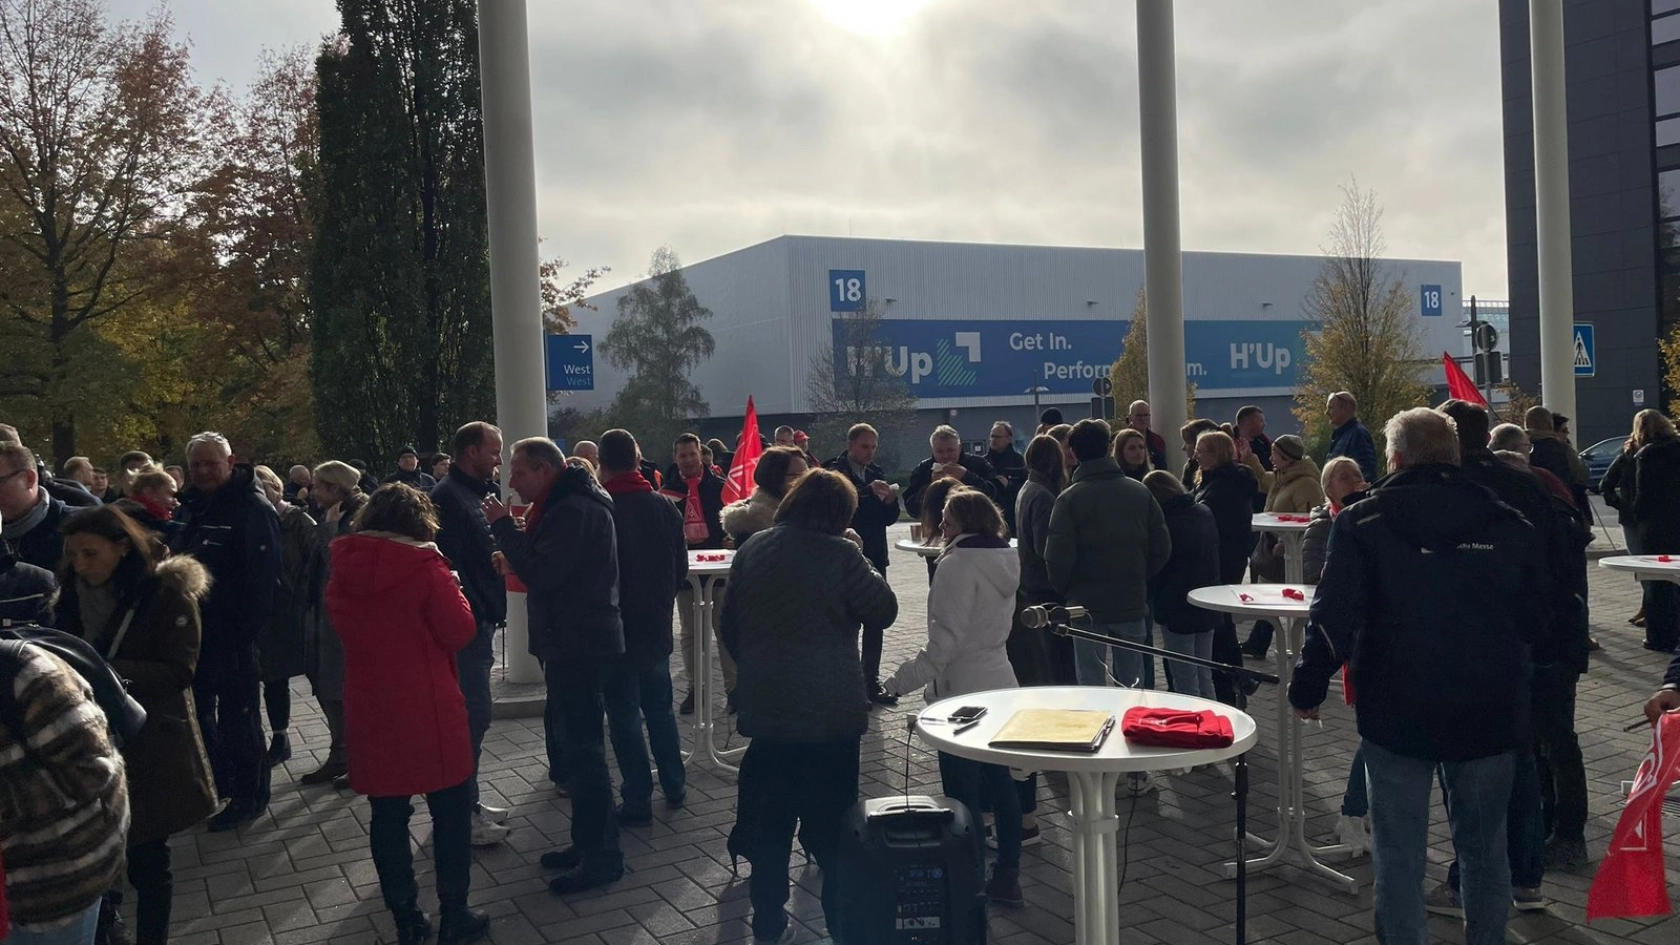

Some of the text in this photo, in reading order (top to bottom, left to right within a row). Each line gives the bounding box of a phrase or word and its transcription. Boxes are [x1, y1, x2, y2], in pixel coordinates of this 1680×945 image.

[835, 278, 861, 301] 18
[1424, 291, 1439, 309] 18
[1009, 332, 1072, 350] Get In.
[1230, 343, 1291, 374] H'Up
[563, 364, 591, 374] West
[566, 376, 591, 386] West
